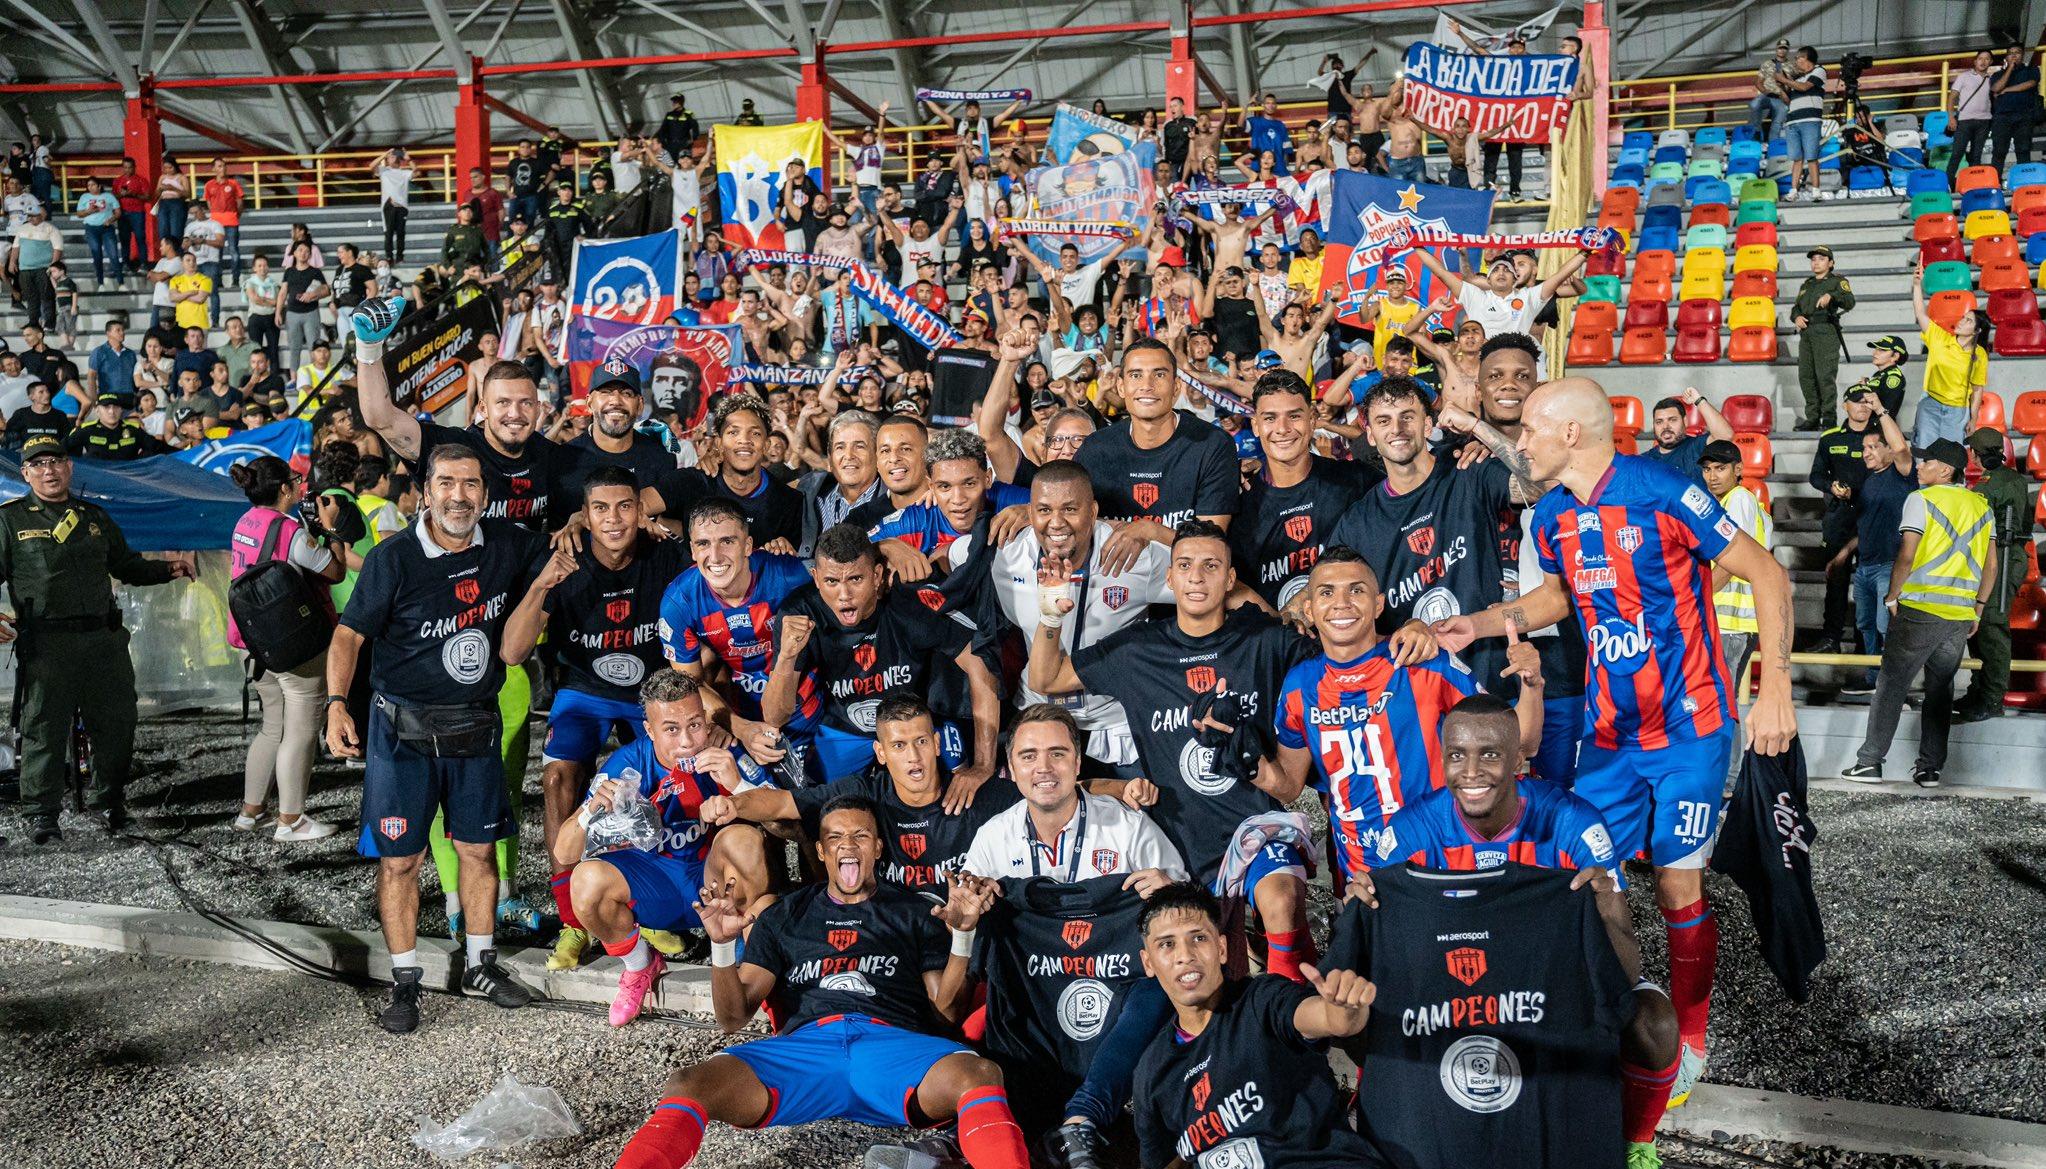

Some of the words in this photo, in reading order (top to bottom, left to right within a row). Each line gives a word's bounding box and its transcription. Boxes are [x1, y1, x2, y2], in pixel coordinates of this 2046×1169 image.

[1404, 46, 1433, 83] LA
[1436, 54, 1523, 96] BANDA
[1525, 57, 1574, 95] DEL
[1183, 189, 1278, 202] CIENAGA
[1012, 222, 1072, 232] ADRIAN
[1074, 222, 1112, 234] VIVE
[1365, 212, 1383, 226] LA
[1434, 229, 1459, 243] DE
[1463, 227, 1582, 245] NOVIEMBRE
[398, 356, 410, 373] UN
[412, 341, 434, 365] BUEN
[611, 329, 667, 360] SIEMPRE
[672, 329, 680, 340] A
[395, 380, 410, 402] NO
[410, 355, 437, 387] TIENE
[1288, 502, 1313, 514] aerosport
[1388, 536, 1467, 609] CAMPEONES
[1576, 567, 1616, 583] MEGA
[1588, 612, 1651, 667] Pool
[1189, 652, 1218, 663] aerosport
[830, 664, 912, 699] AMPEONES
[1310, 691, 1393, 726] BetPlay
[1320, 723, 1400, 822] 24
[1674, 800, 1711, 839] 30
[1264, 842, 1288, 860] 17
[1449, 930, 1490, 942] aerosport
[1027, 953, 1131, 979] CAMPEONES
[1402, 990, 1546, 1037] CAMPEONES
[1470, 1078, 1496, 1086] BetPlay
[1176, 1081, 1264, 1160] MPEONES
